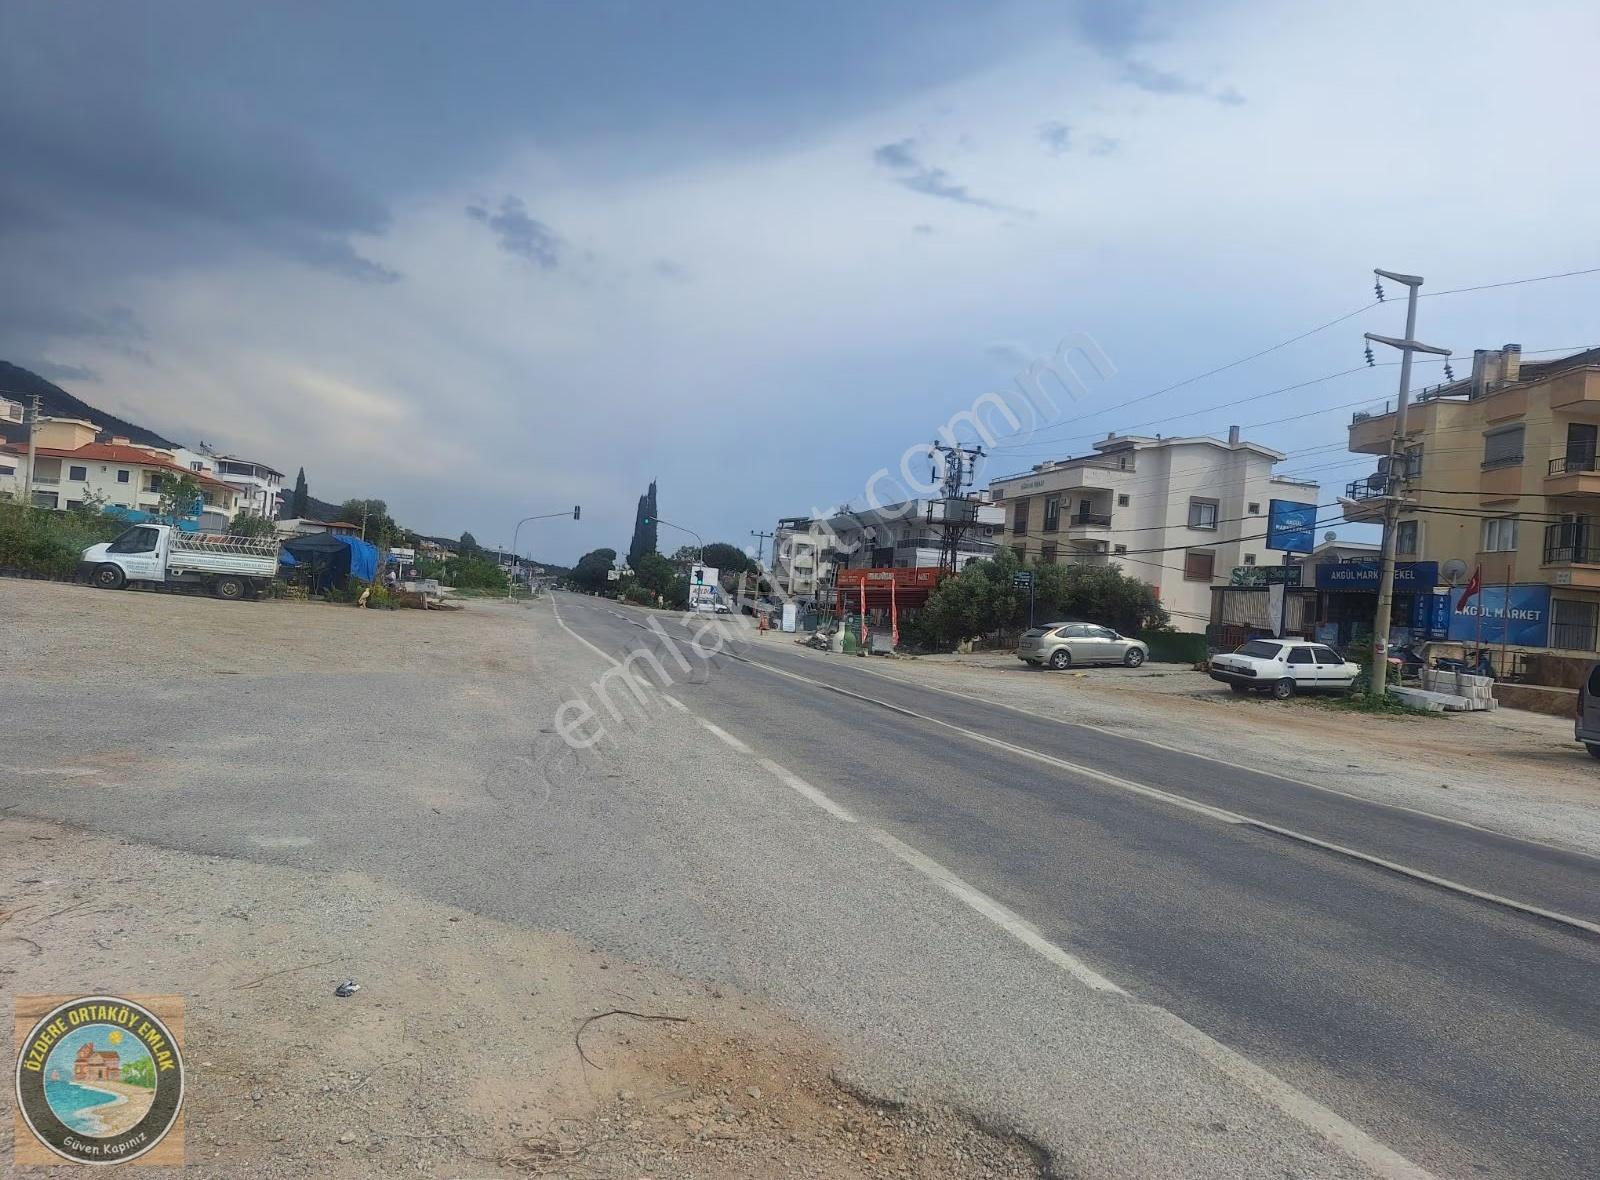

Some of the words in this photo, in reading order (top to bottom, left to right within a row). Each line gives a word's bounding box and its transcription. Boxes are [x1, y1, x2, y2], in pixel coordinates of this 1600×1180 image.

[1331, 569, 1355, 580] AKGÜL
[1357, 570, 1382, 580] MARK
[1394, 570, 1415, 580] EKEL
[1494, 606, 1541, 621] MARKET
